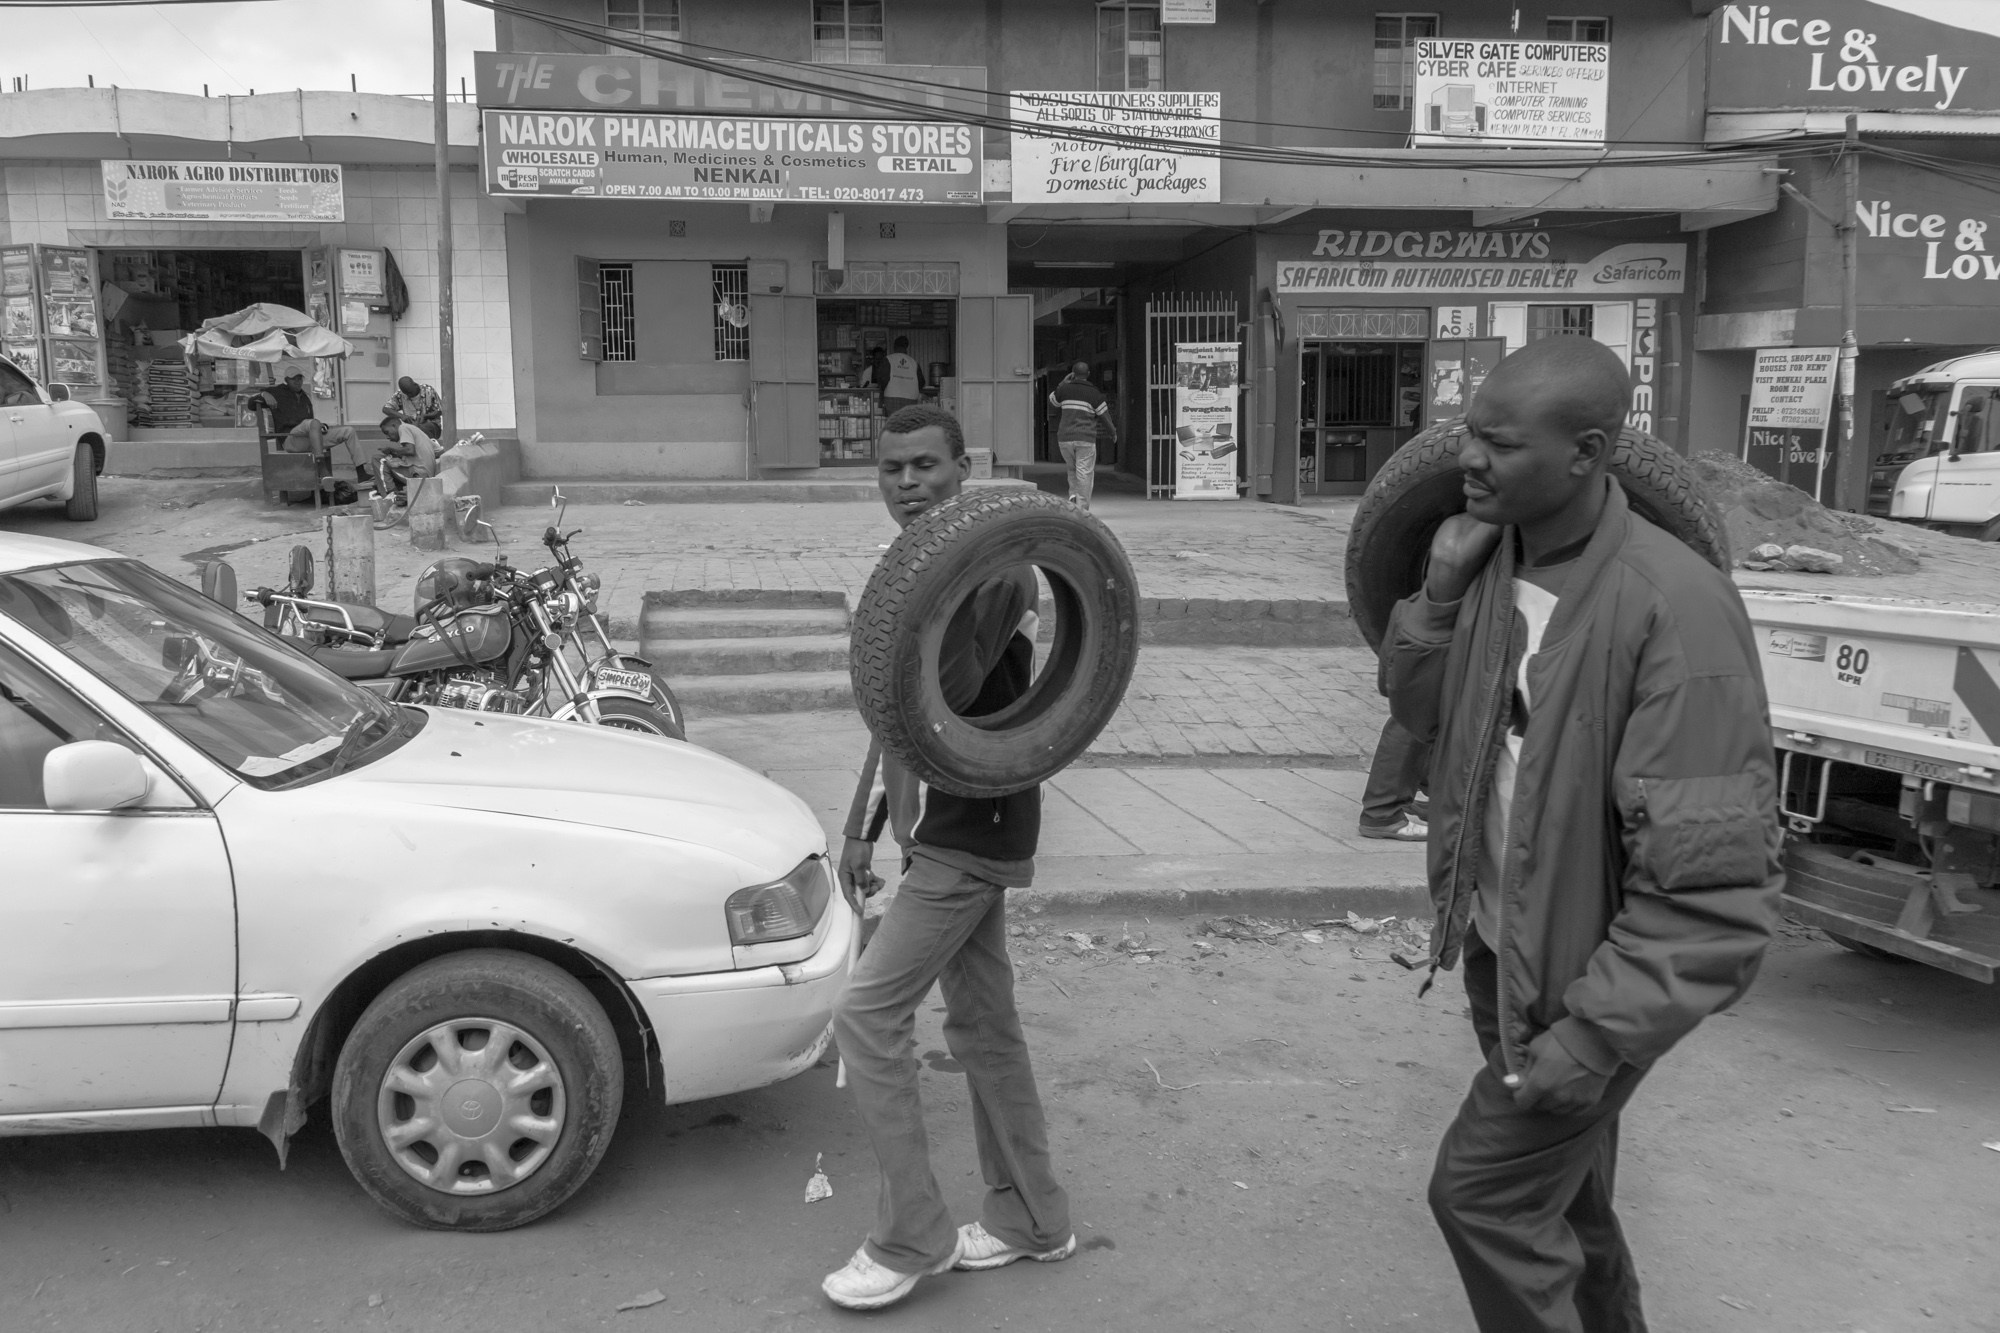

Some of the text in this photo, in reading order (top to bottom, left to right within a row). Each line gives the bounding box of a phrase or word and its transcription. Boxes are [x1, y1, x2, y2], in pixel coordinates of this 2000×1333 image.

[1720, 5, 1831, 46] Nice
[1418, 42, 1607, 62] SILVER GATE COMPUTERS
[1840, 29, 1879, 63] &
[1417, 60, 1469, 77] CYBER
[1477, 61, 1516, 78] CAFE
[1518, 65, 1564, 77] SERVICES
[495, 55, 556, 104] THE
[1496, 81, 1558, 94] INTERNET
[1808, 53, 1968, 110] Lovely
[1072, 93, 1155, 107] STATIONERS
[1158, 93, 1219, 107] SUPPLIERS
[1494, 96, 1588, 108] COMPUTER TRAINING
[1036, 107, 1059, 121] ALL
[1061, 107, 1096, 121] SORTS
[1102, 107, 1117, 121] OF
[1494, 109, 1591, 123] COMPUTER SERVICES
[499, 115, 971, 155] NAROK PHARMACEUTICALS STORES
[1050, 141, 1106, 154] Motor
[507, 151, 595, 165] WHOLESALE
[604, 151, 866, 168] Human, Medicines & Cosmetics
[892, 158, 957, 172] RETAIL
[126, 164, 339, 183] NAROK AGRO DISTRIBUTORS
[539, 168, 595, 178] SCRATCH CARDS
[693, 167, 780, 184] NENKAI
[606, 185, 783, 198] OPEN 7.00 AM TO 10.00 PM DAILY
[1046, 174, 1207, 196] Domestic packages
[799, 187, 924, 201] TEL: 020-8017 473
[1856, 200, 1946, 238] Nice
[1954, 218, 1987, 251] &
[1312, 229, 1551, 259] RIDGEWAYS
[1923, 241, 2000, 280] Lov
[1280, 266, 1578, 289] SAFARICOM AUTHORISED DEALER
[1602, 265, 1681, 282] Safaricom
[1791, 354, 1814, 362] SHOPS
[1815, 354, 1832, 362] AND
[1759, 364, 1787, 372] HOUSES
[1755, 376, 1827, 384] VISIT NENKAI PLAZA
[1769, 385, 1805, 393] ROOM 210
[1182, 405, 1232, 414] Swagtech
[1836, 644, 1870, 675] 80
[1837, 671, 1862, 686] KPH
